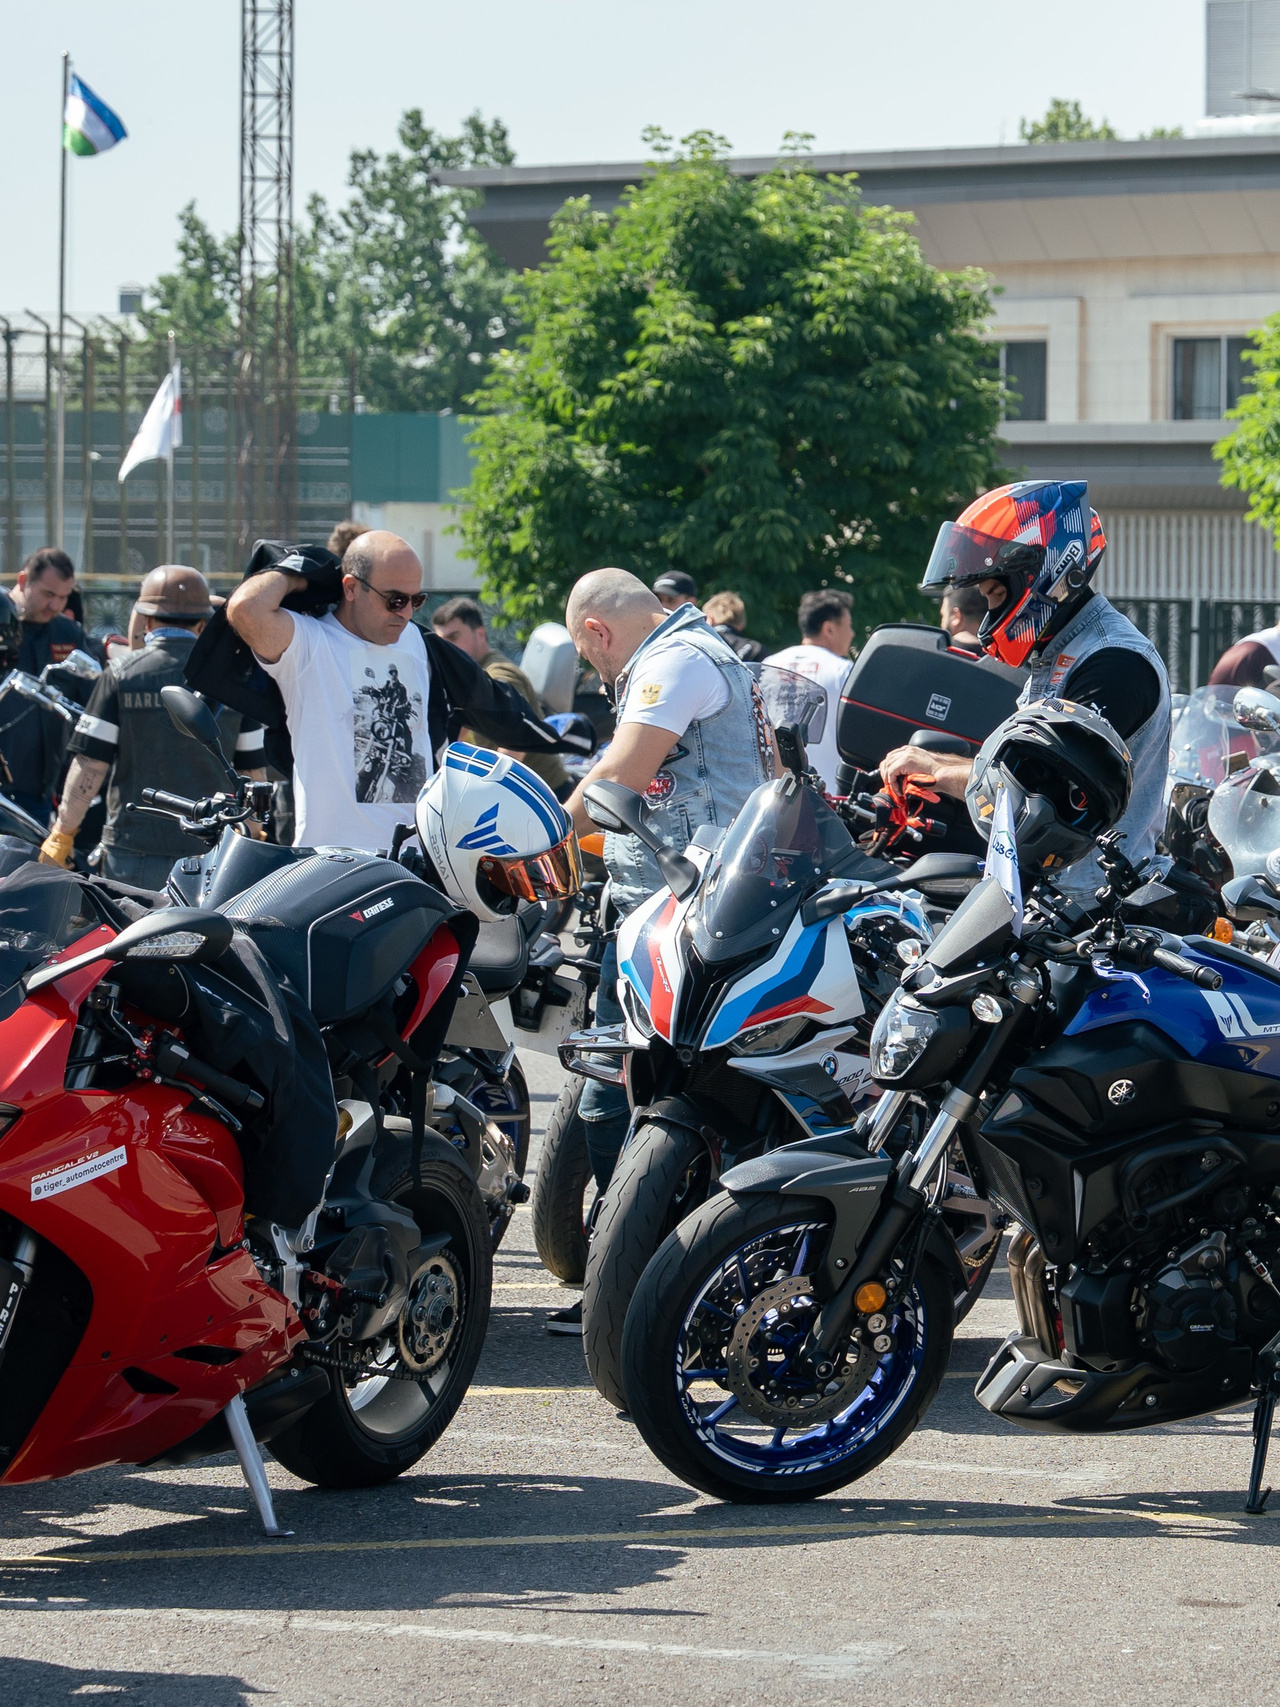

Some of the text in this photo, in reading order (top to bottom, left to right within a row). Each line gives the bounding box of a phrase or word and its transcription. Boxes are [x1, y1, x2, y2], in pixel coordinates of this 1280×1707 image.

[123, 692, 166, 708] HARL
[31, 1151, 99, 1182] PANIGALE V2
[43, 1153, 125, 1192] tiger_automotocentre
[848, 1185, 877, 1194] ABS
